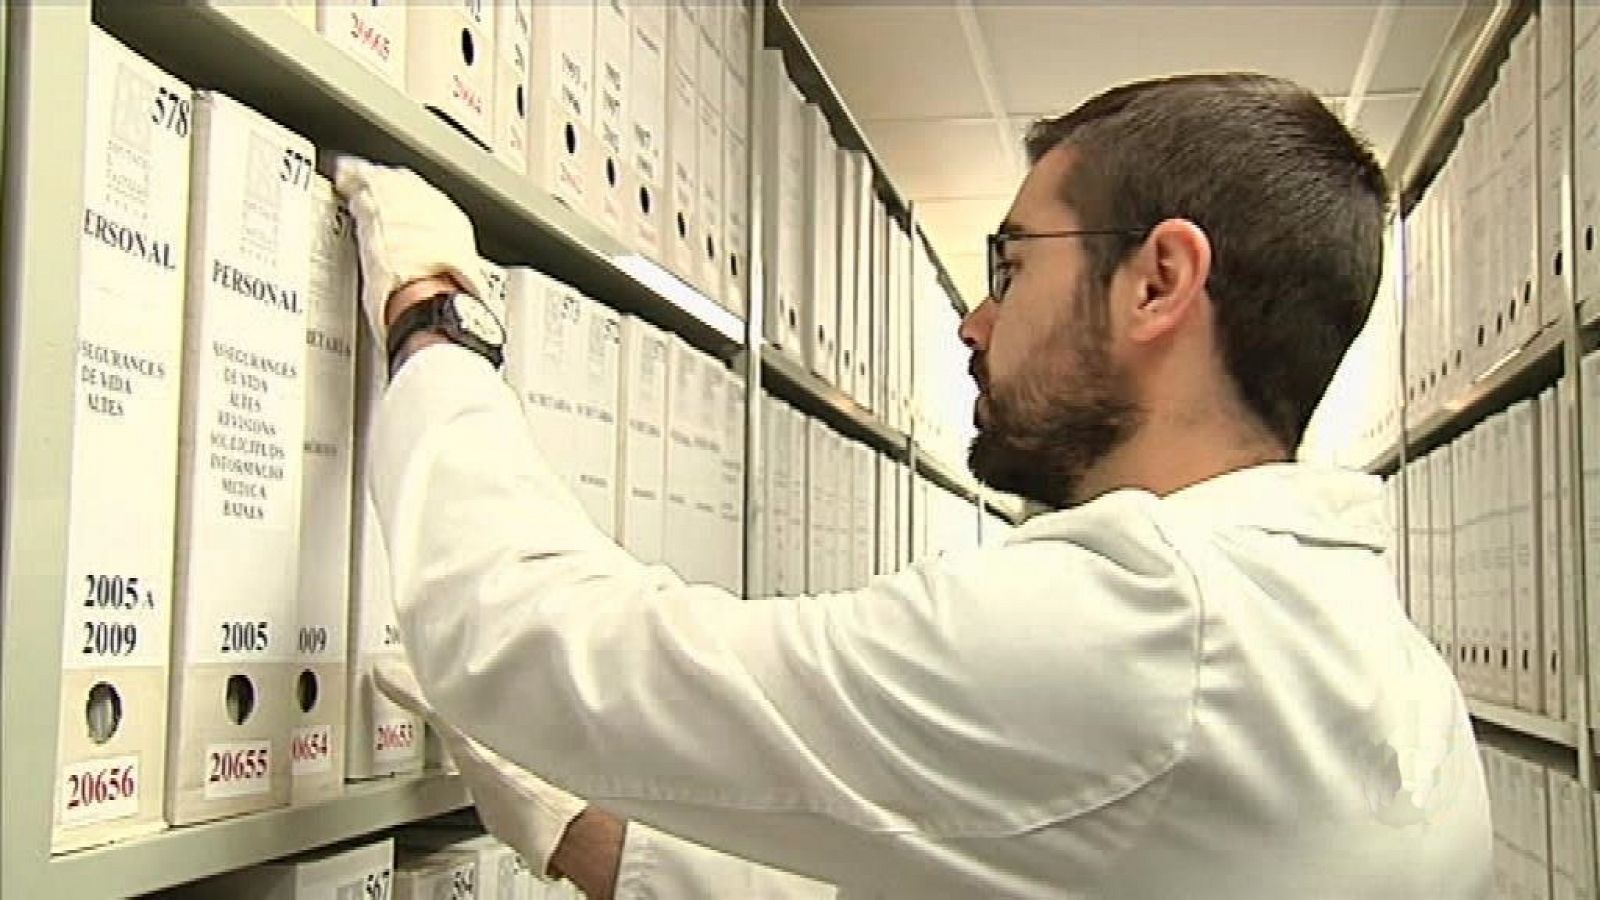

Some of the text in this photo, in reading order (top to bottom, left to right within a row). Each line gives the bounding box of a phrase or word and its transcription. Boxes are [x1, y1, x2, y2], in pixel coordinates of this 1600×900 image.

[152, 86, 190, 138] 578
[280, 149, 312, 192] 577
[212, 258, 303, 313] PERSONAL
[83, 574, 141, 610] 2005
[82, 621, 138, 656] 2009
[220, 621, 269, 653] 2005
[208, 749, 268, 783] 20655
[66, 765, 136, 811] 20656
